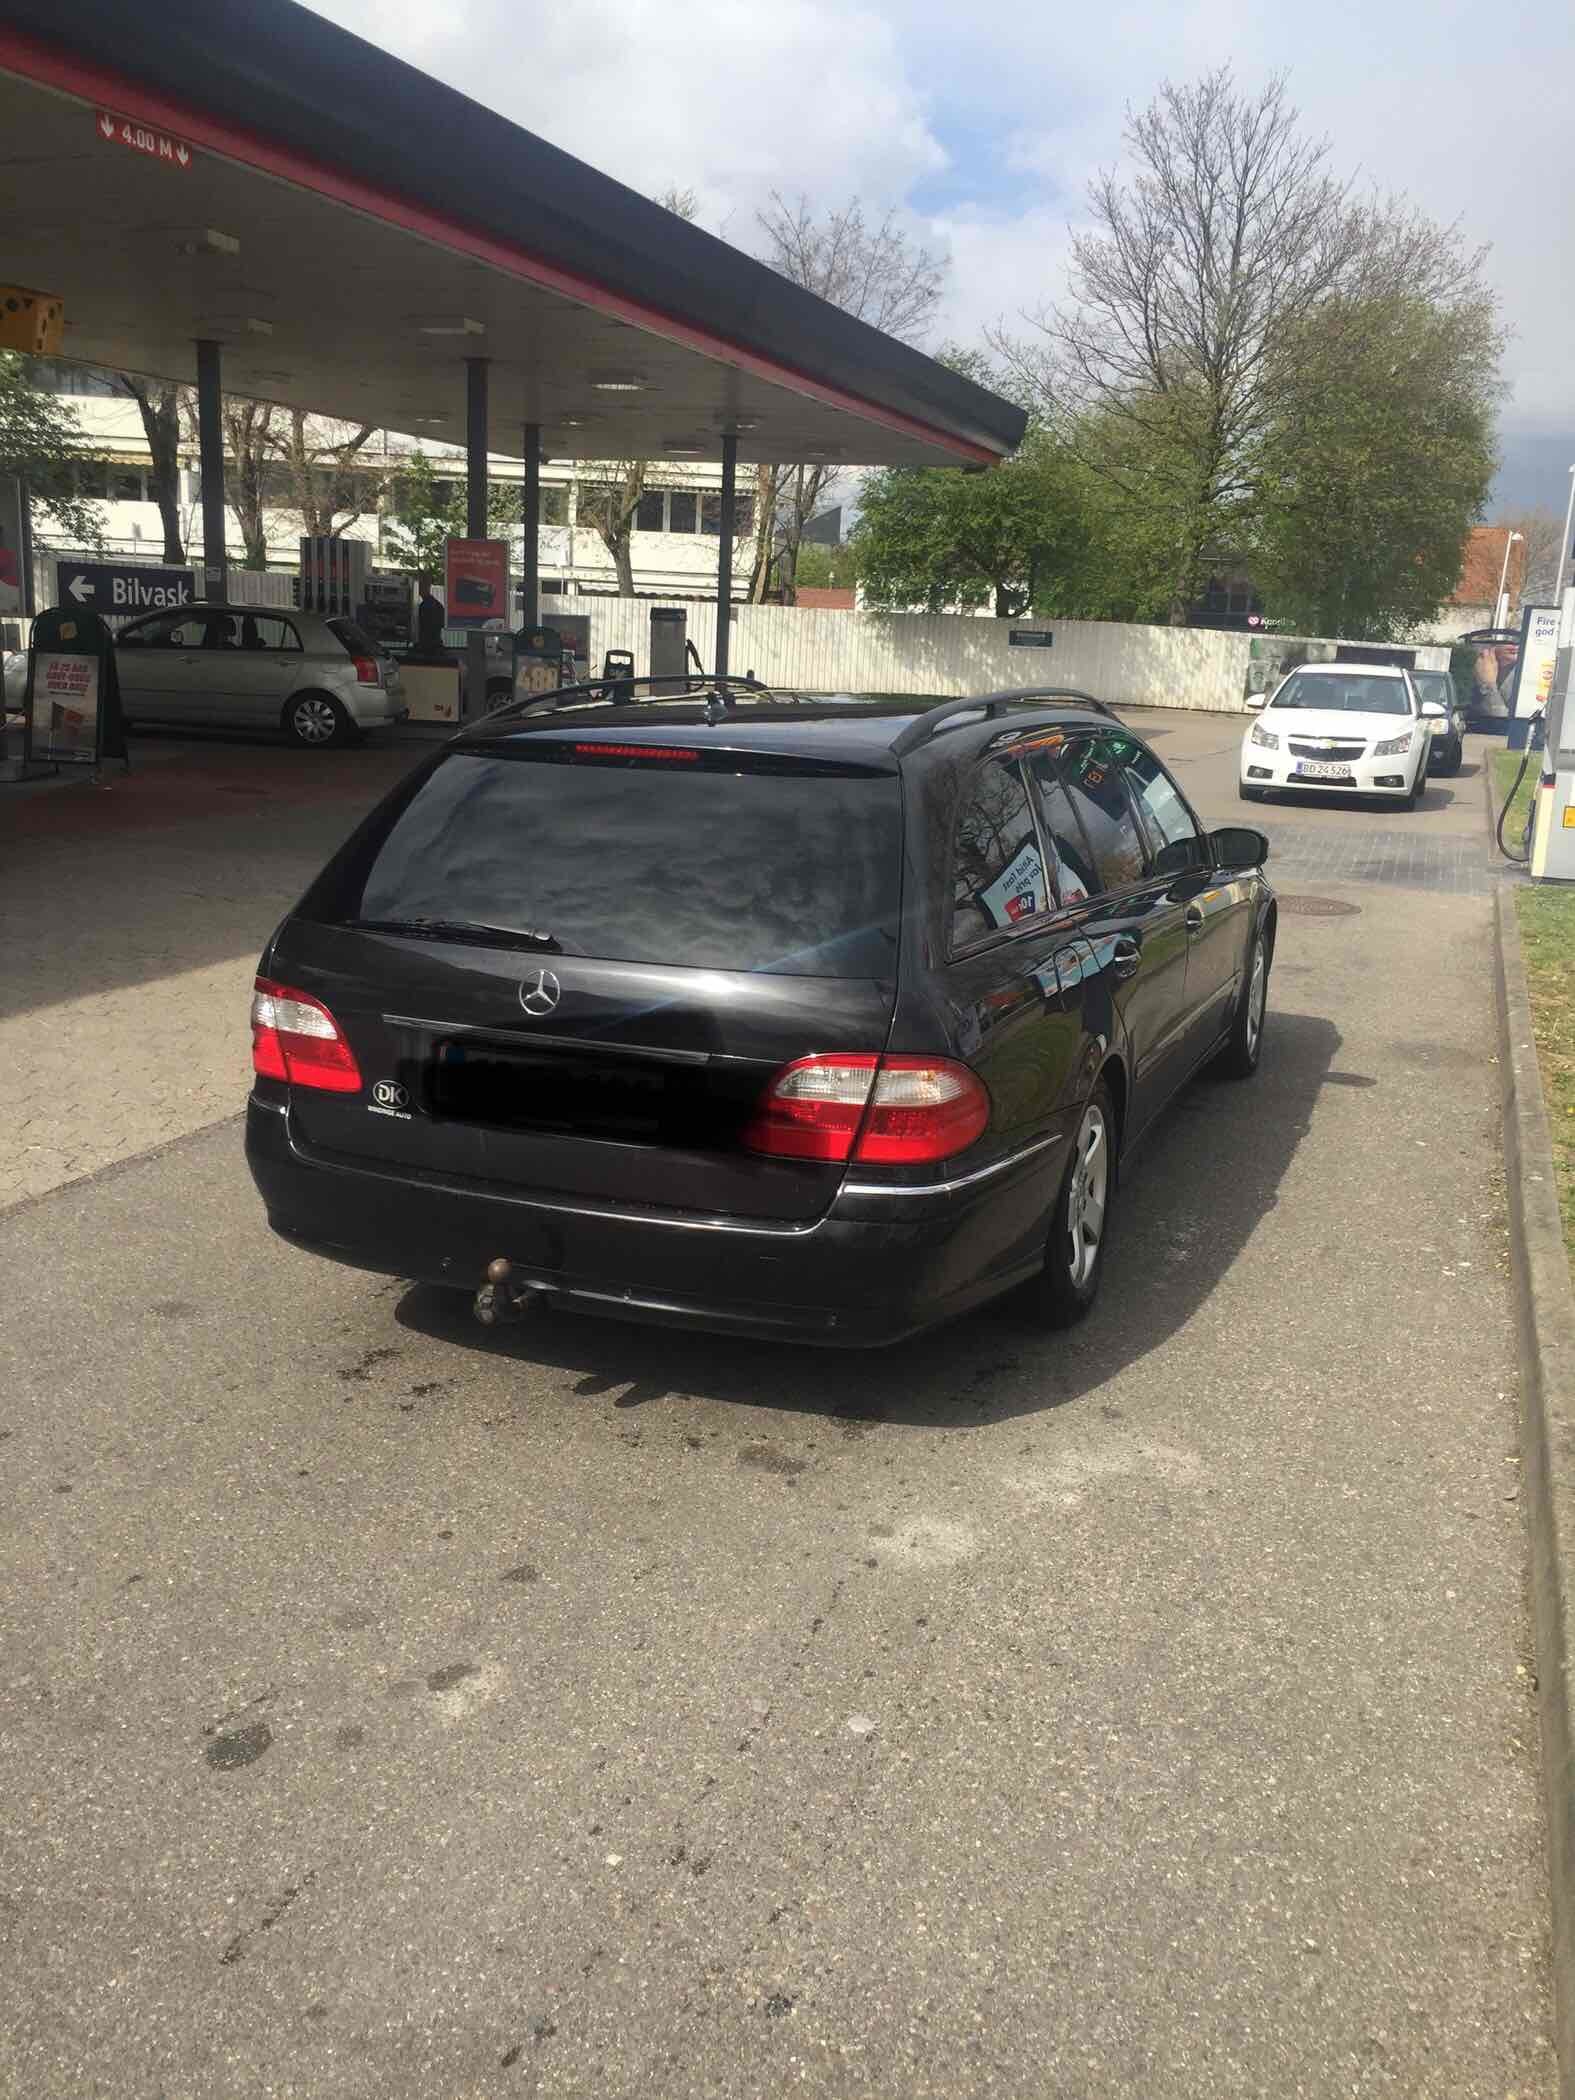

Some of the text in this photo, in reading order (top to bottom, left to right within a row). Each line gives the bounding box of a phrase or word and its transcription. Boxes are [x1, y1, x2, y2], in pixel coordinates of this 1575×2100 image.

[160, 138, 172, 159] M
[112, 577, 190, 607] Bilvask
[378, 1084, 404, 1105] DK
